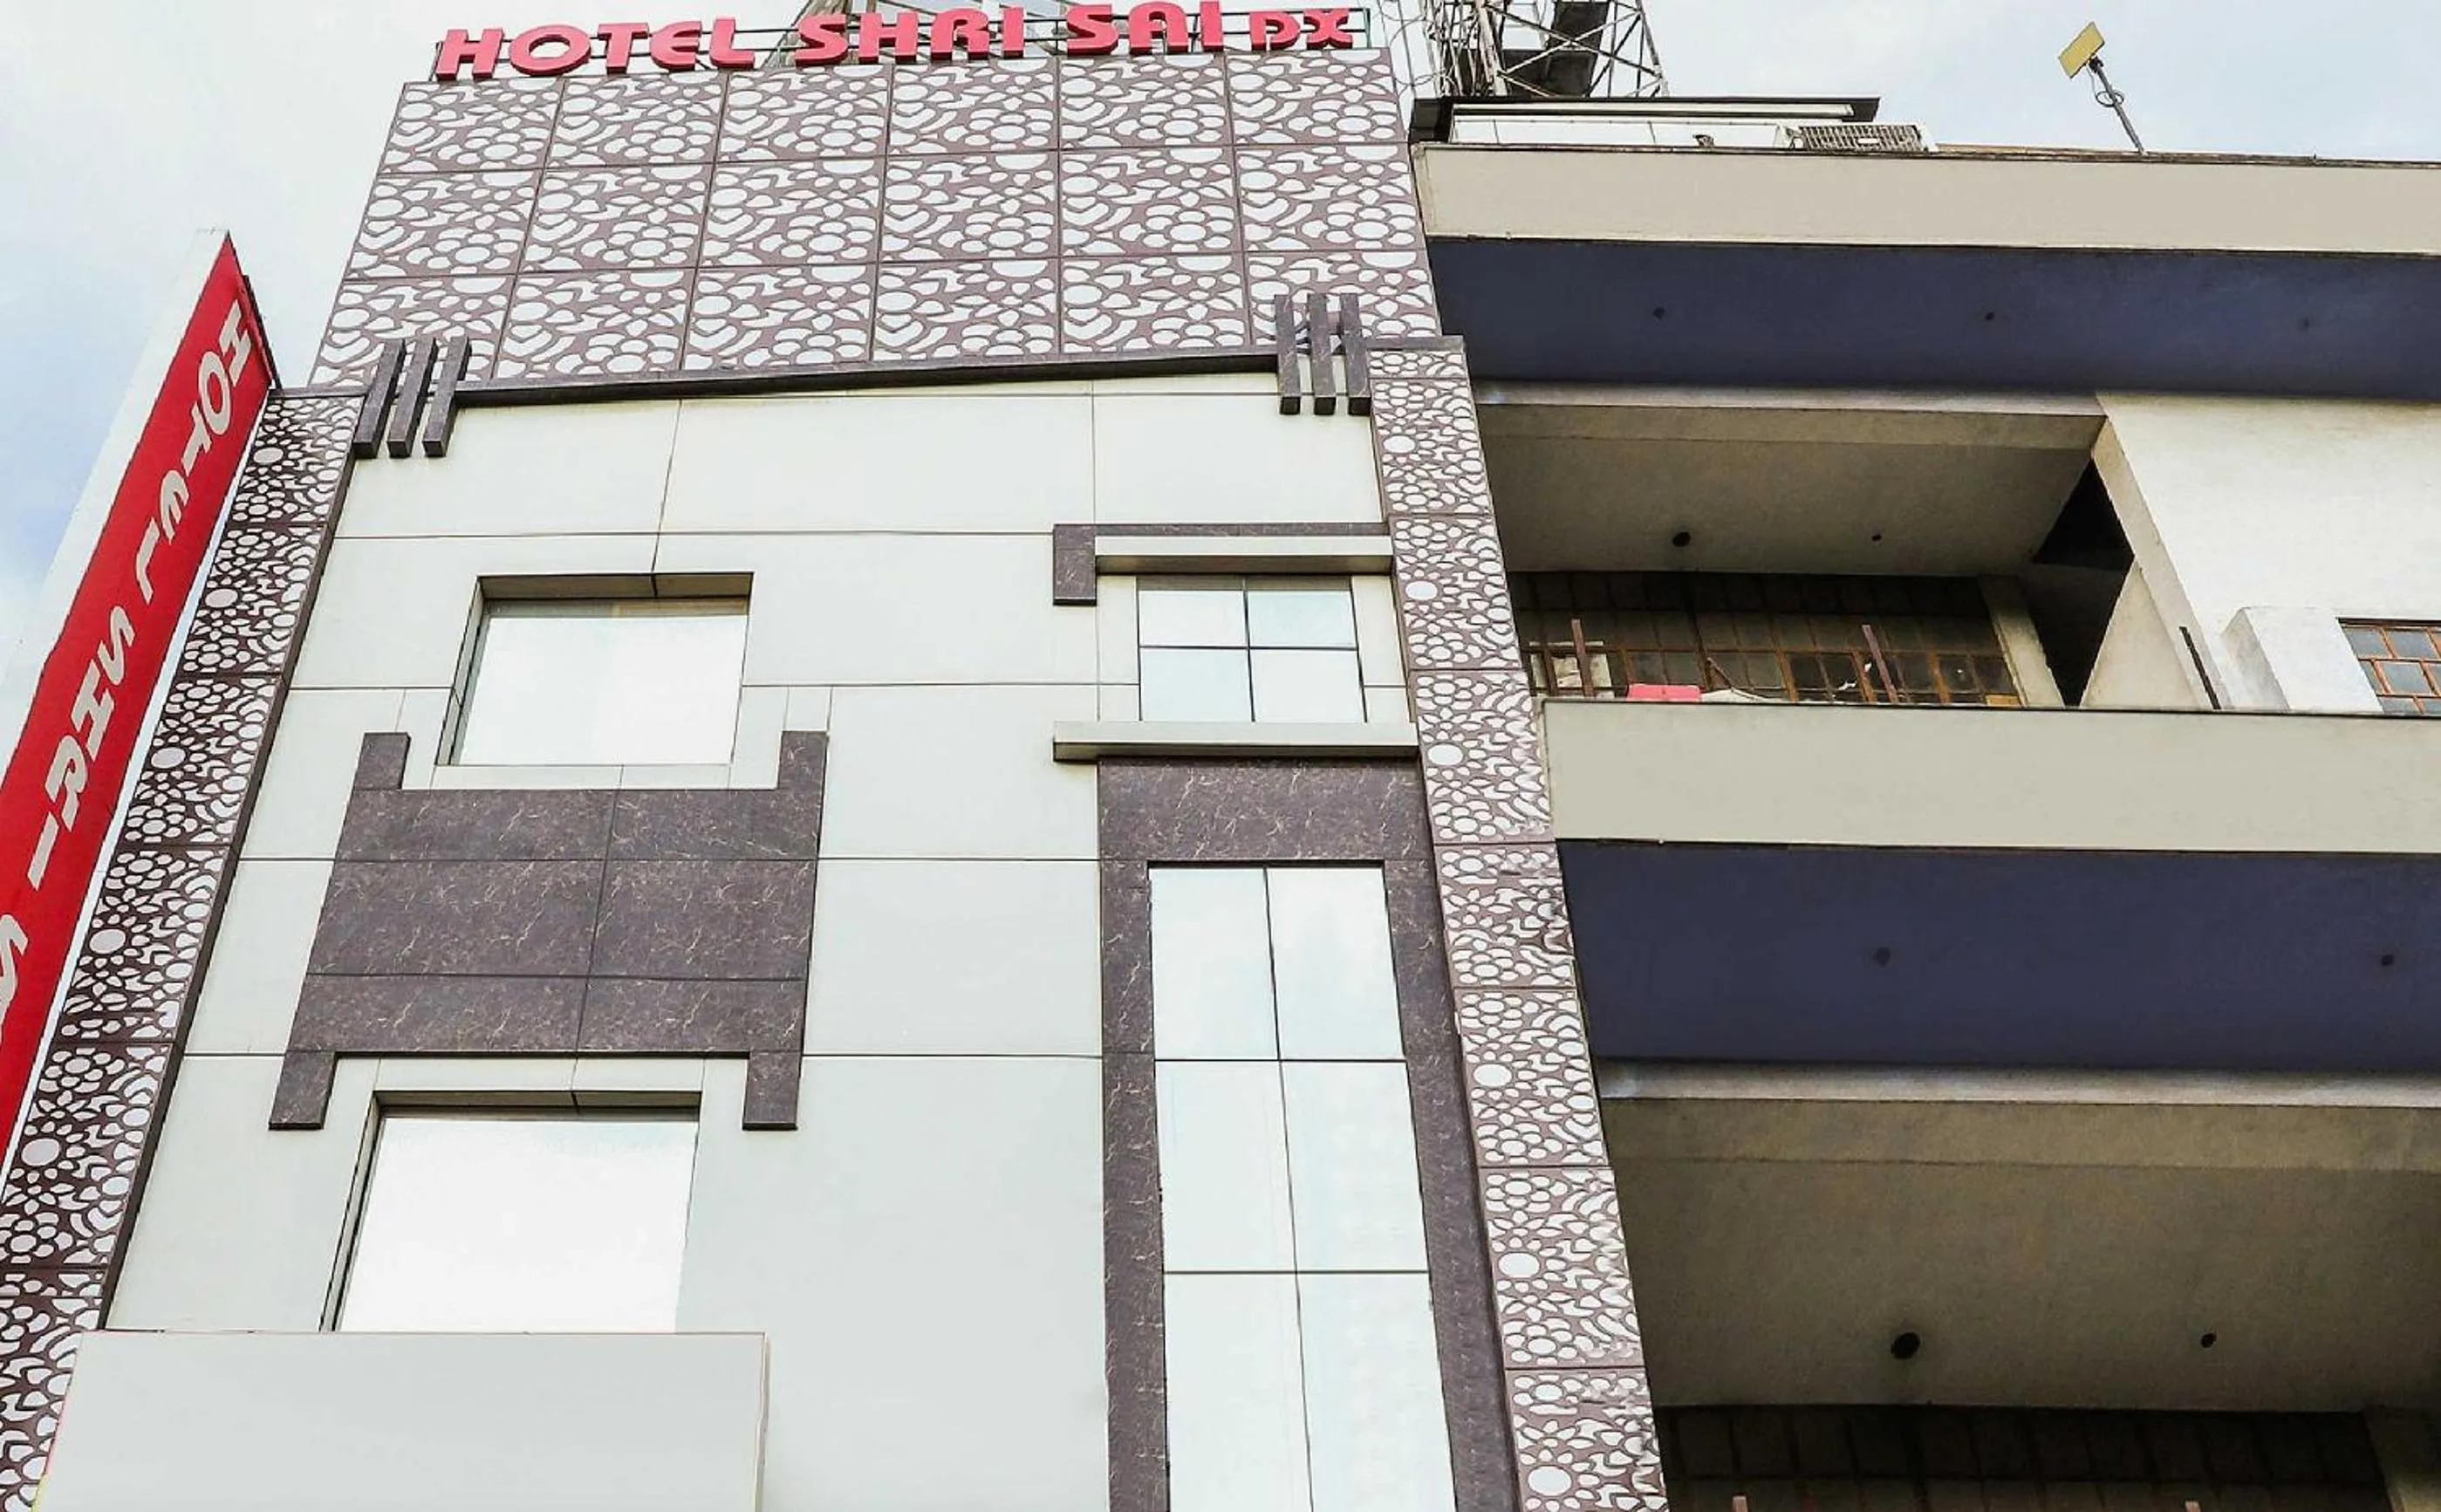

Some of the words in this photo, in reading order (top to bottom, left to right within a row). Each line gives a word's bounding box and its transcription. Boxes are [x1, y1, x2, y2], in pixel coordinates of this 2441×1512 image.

[436, 17, 756, 83] HOTEL
[795, 6, 1025, 67] SHRI
[1066, 0, 1224, 56] SAI
[1248, 8, 1353, 51] DX
[133, 300, 252, 605] HOTEL
[28, 605, 135, 891] SHRI
